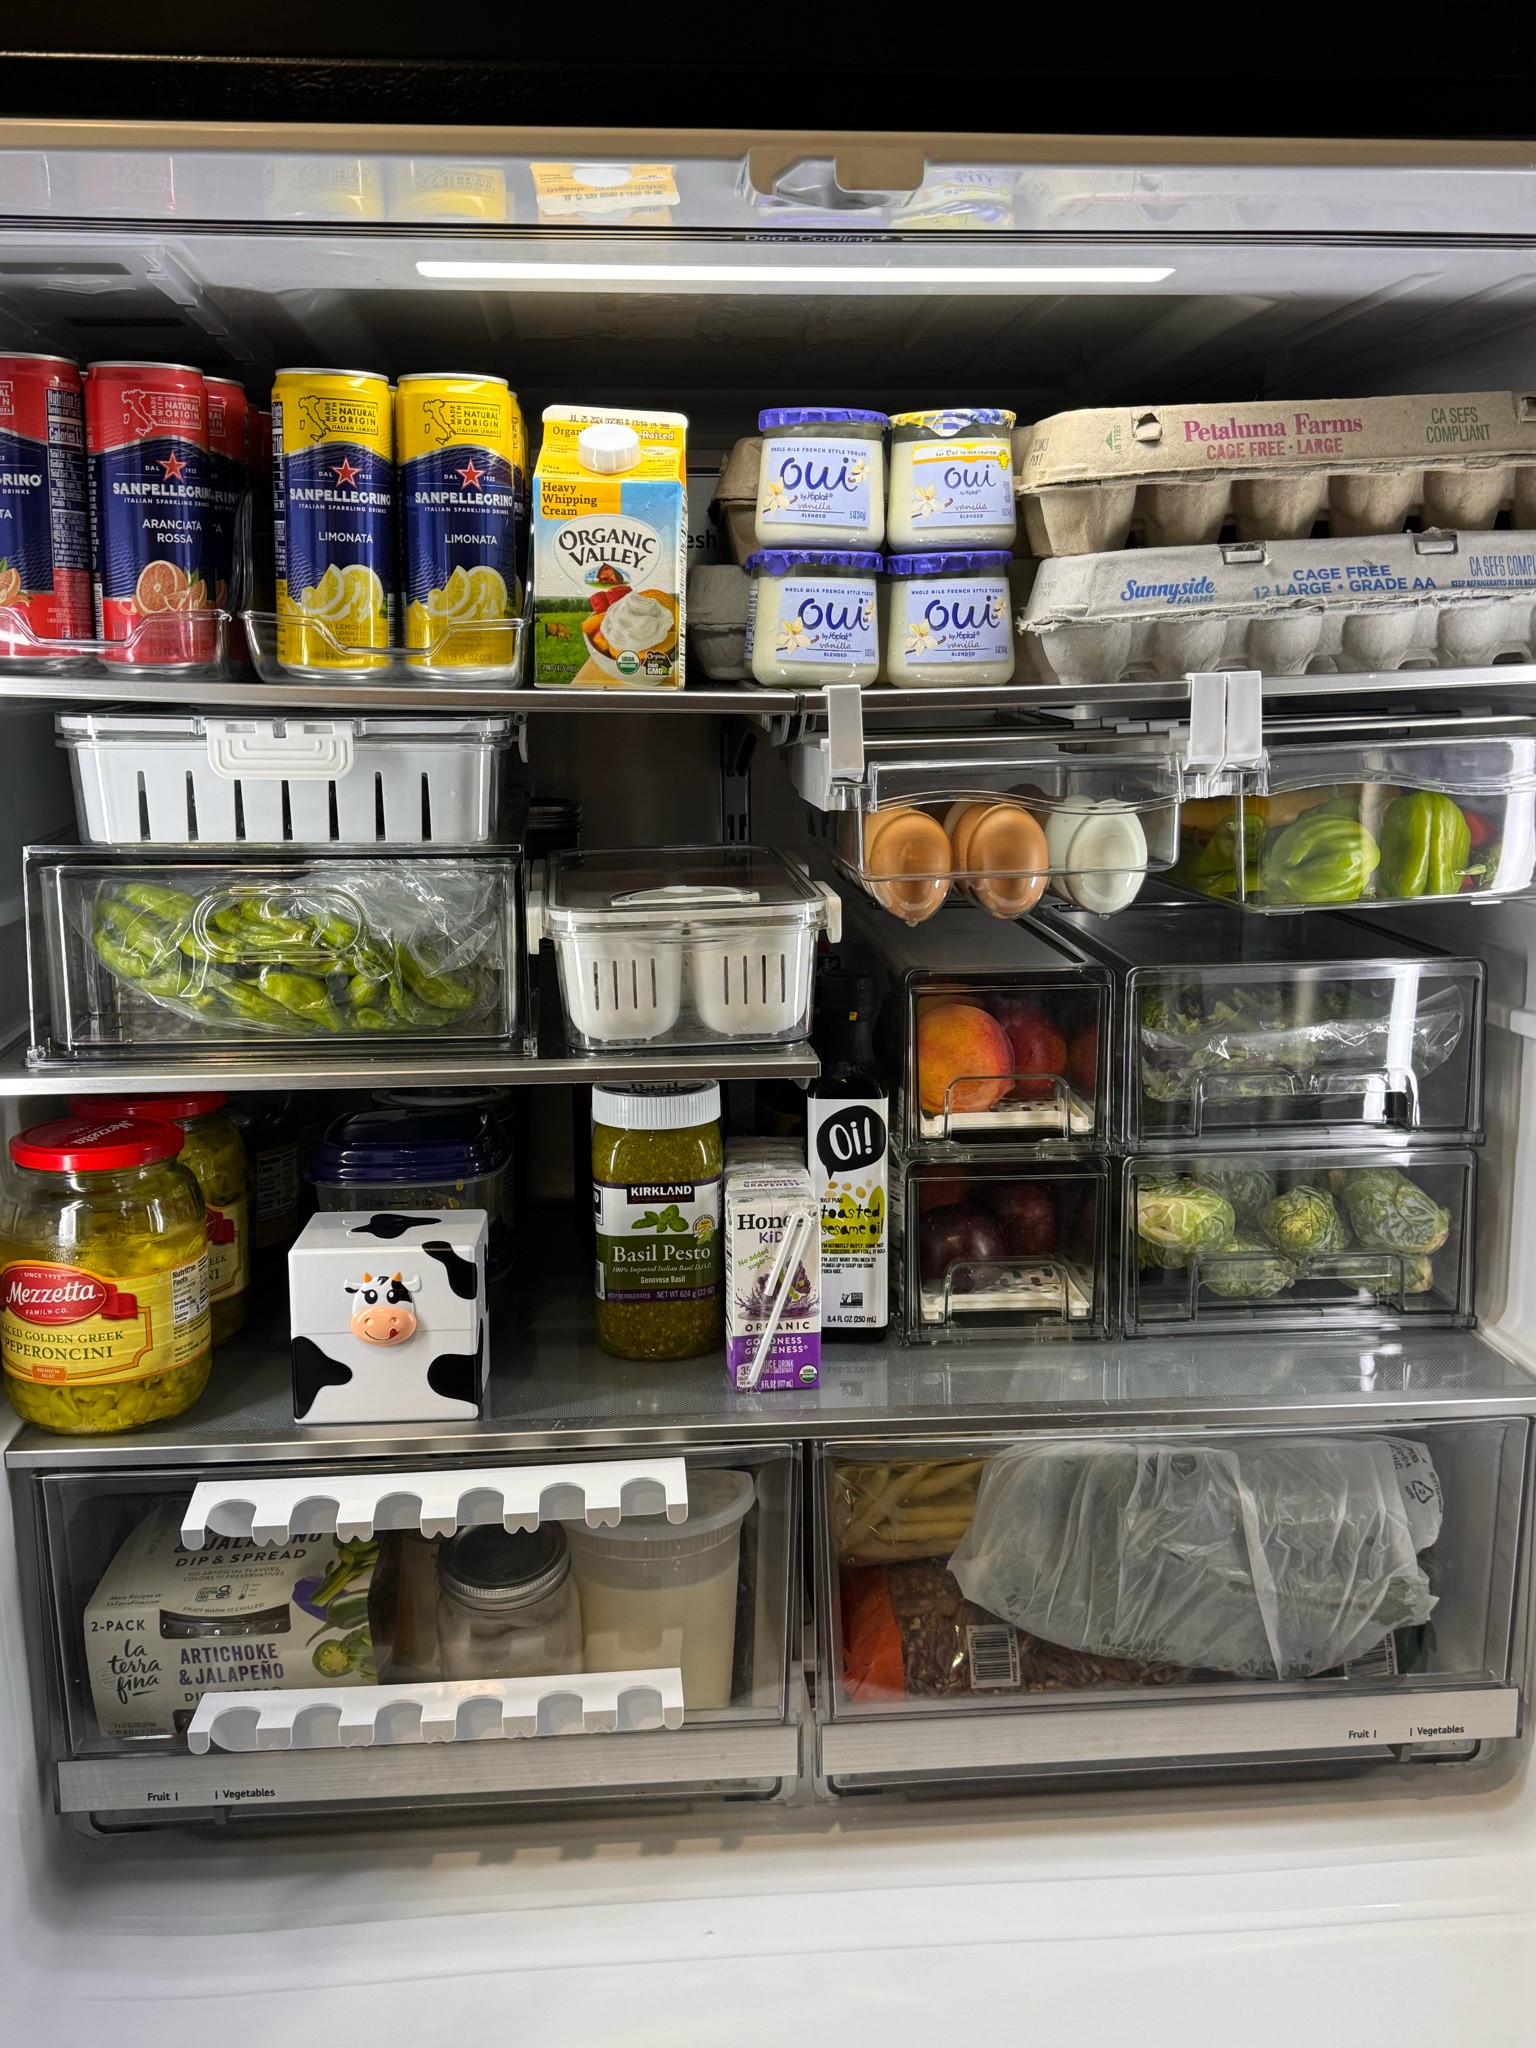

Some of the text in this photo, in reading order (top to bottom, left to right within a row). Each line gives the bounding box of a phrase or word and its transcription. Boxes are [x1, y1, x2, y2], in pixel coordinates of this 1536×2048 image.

[164, 401, 200, 412] NATURAL
[338, 407, 376, 418] NATURAL
[164, 410, 200, 420] ORIGIN
[339, 416, 376, 426] ORIGIN
[463, 410, 499, 421] NATURAL
[569, 414, 603, 425] JUL 25 2024
[1431, 407, 1479, 425] CA SEFS
[463, 419, 499, 428] ORIGIN
[1183, 412, 1363, 443] Petaluma Farms
[552, 426, 585, 438] Organ
[1113, 424, 1122, 443] SELL
[1426, 424, 1491, 443] COMPLIANT
[1206, 437, 1344, 461] CAGE FREE LARGE
[780, 457, 858, 493] Oui
[944, 464, 997, 490] Oui
[542, 481, 577, 495] Heavy
[155, 498, 193, 506] SPARKLING
[289, 487, 392, 507] SANPELLEGRINO
[414, 491, 513, 508] SANPELLEGRINO
[542, 493, 598, 508] Whipping
[328, 504, 366, 512] SPARKLING
[542, 505, 578, 516] Cream
[797, 502, 832, 511] vanilla
[955, 502, 988, 511] vanilla
[142, 518, 202, 531] ARANCIATA
[157, 533, 194, 544] ROSSA
[318, 531, 374, 544] LIMONATA
[444, 534, 498, 545] LIMONATA
[558, 528, 657, 554] ORGANIC
[687, 529, 717, 549] esh
[568, 546, 648, 570] VALLEY
[1292, 564, 1392, 582] CAGE FREE
[1469, 556, 1482, 577] CA
[1483, 556, 1506, 577] SEFS
[1120, 576, 1214, 605] Sunnyside
[1252, 576, 1437, 600] 12 LARGE GRADE AA
[1177, 594, 1215, 605] FARMS
[798, 597, 870, 631] Oui
[924, 595, 1000, 631] Oui
[819, 641, 852, 650] vanilla
[946, 640, 980, 649] vanilla
[647, 667, 664, 675] GMO
[829, 1117, 872, 1160] Oi!
[631, 1185, 692, 1197] KIRKLAND
[821, 1203, 880, 1219] toasted
[821, 1218, 884, 1235] sesame oil
[613, 1244, 711, 1262] Basil Pesto
[738, 1247, 769, 1267] No added
[630, 1265, 657, 1274] Imported
[173, 1276, 188, 1287] Facts
[640, 1275, 686, 1284] Genovese Basil
[6, 1280, 97, 1306] Mezzetta
[656, 1289, 691, 1299] NET WT 624
[25, 1308, 53, 1316] FAMILY
[827, 1315, 836, 1323] 8.4
[854, 1315, 866, 1323] (250
[1, 1322, 125, 1343] LICED GOLDEN GREEK
[745, 1321, 810, 1333] ORANIC
[5, 1336, 113, 1361] PEPERONCINI
[746, 1337, 802, 1346] GODNESS
[175, 1549, 307, 1567] DIP & SPREAD
[201, 1568, 243, 1576] ARTIFICIAL
[245, 1565, 282, 1574] FLAVORS,
[225, 1571, 285, 1580] PRESERVATIVES
[183, 1605, 203, 1613] ENJOY
[235, 1602, 265, 1612] CHILLED
[91, 1619, 146, 1632] 2-PACK
[124, 1639, 148, 1658] la
[180, 1642, 279, 1665] ARTICHOKE
[107, 1654, 162, 1675] terra
[179, 1660, 285, 1686] & JALAPEÑO
[116, 1673, 161, 1704] fina
[1348, 1725, 1465, 1739] Fruit Vegetables
[147, 1788, 276, 1802] Fruit Vegetables
